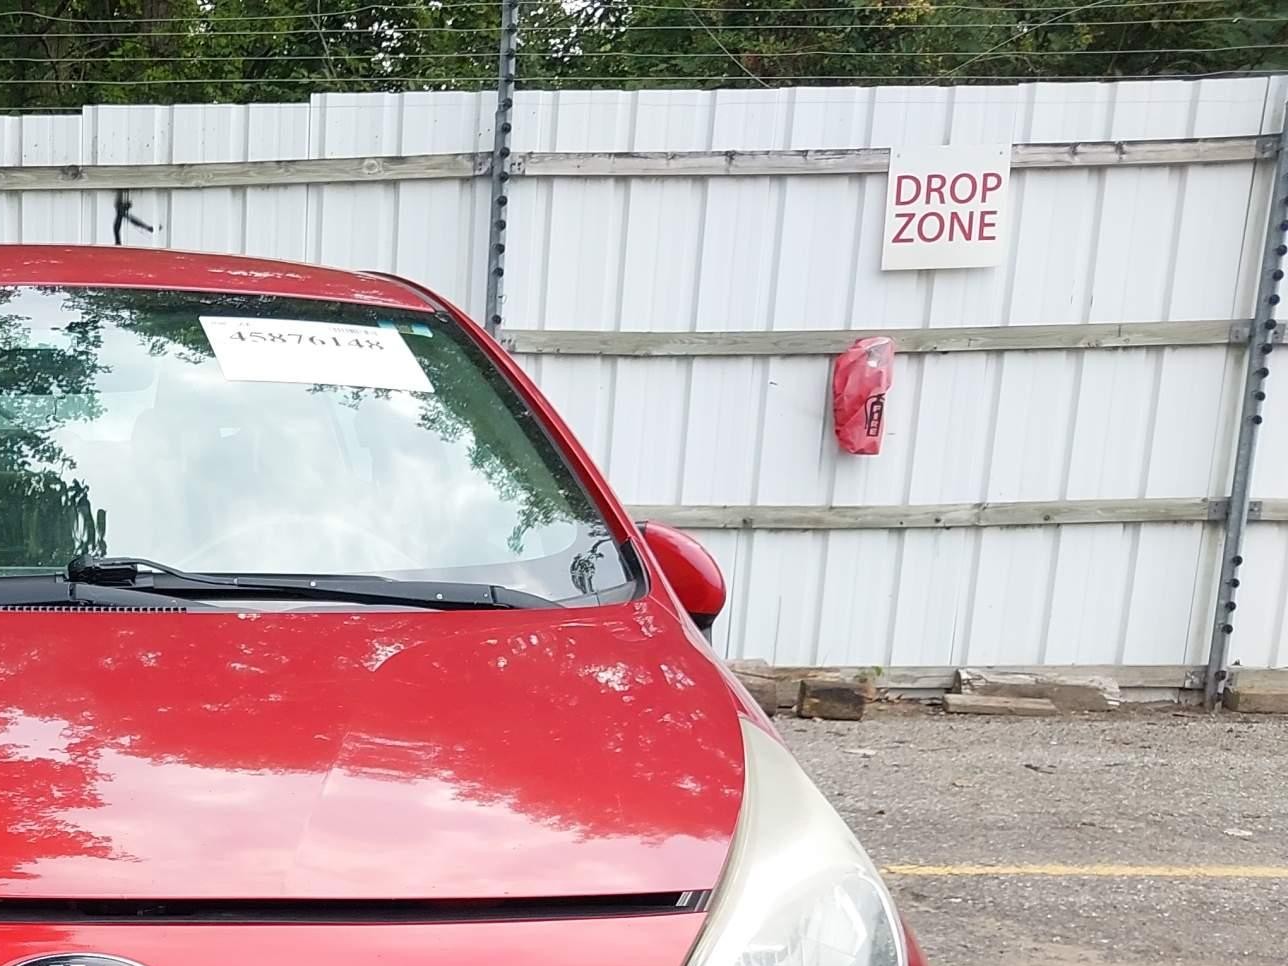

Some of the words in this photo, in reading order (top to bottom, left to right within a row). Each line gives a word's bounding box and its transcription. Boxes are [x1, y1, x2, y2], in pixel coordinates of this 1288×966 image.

[894, 172, 1002, 206] DROP
[891, 210, 998, 244] ZONE
[229, 331, 385, 350] 45876148
